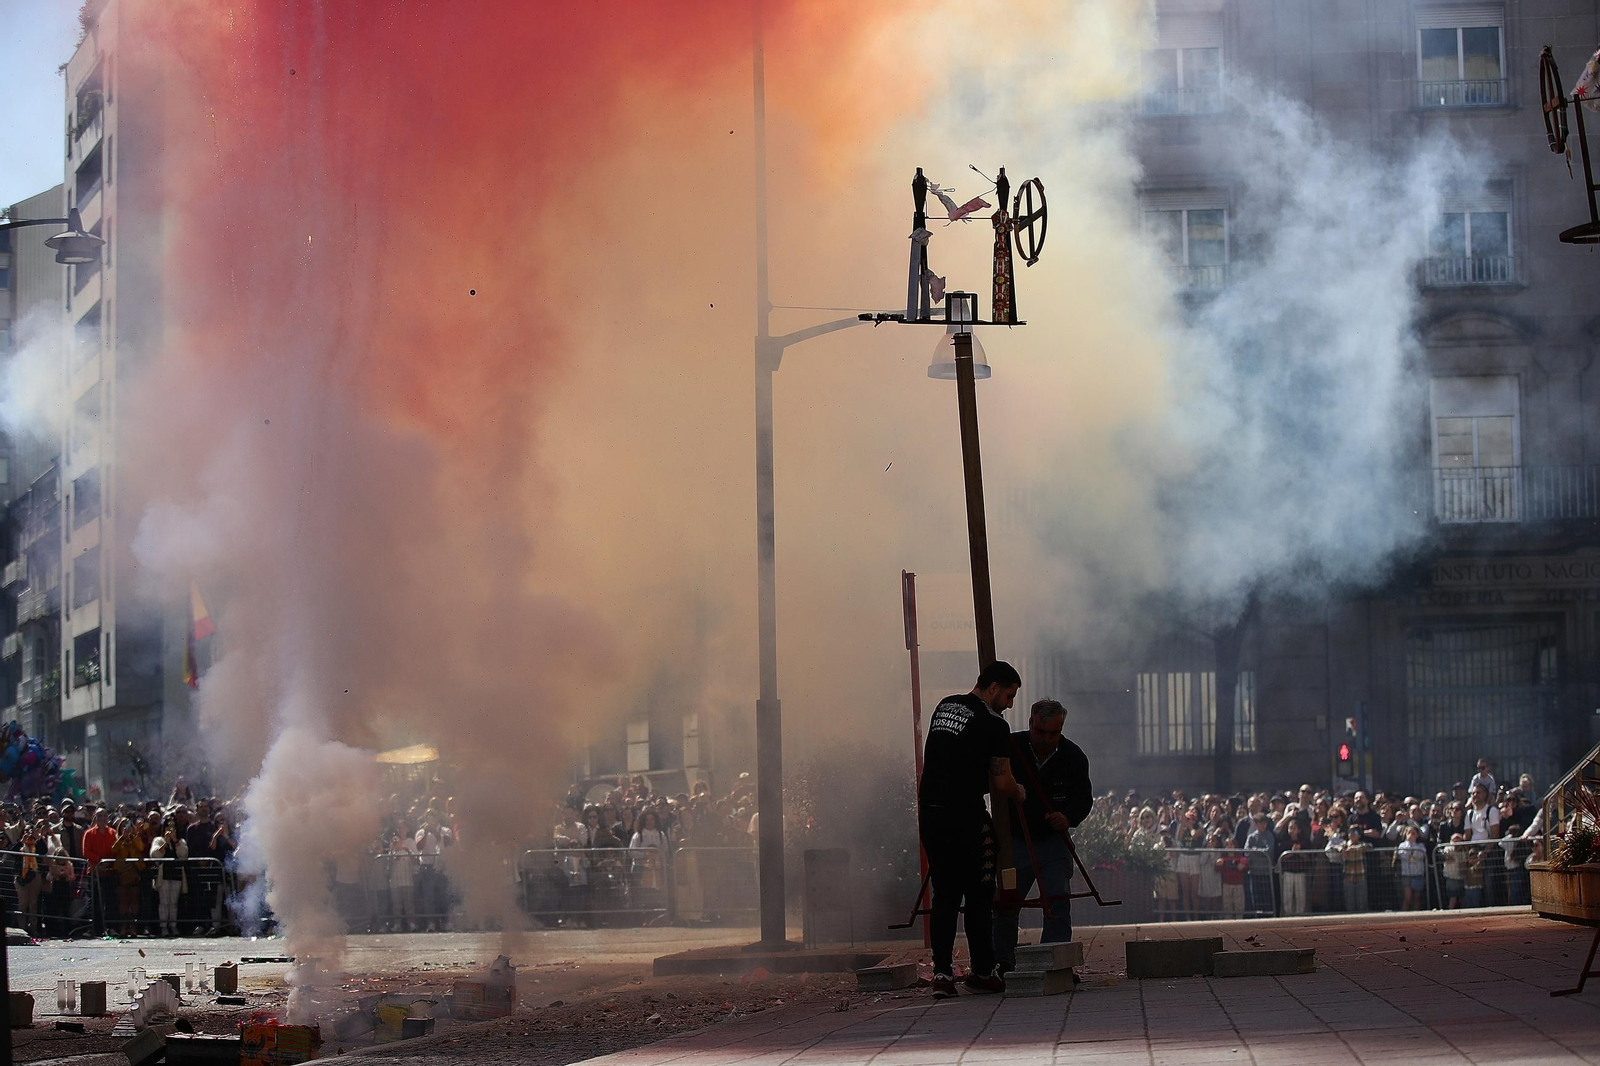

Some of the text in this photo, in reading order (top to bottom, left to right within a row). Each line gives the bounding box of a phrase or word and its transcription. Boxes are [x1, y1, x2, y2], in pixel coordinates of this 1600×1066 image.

[1433, 564, 1532, 581] INSTITUTO
[1545, 589, 1600, 604] GENE
[930, 620, 975, 630] OUREN
[932, 718, 966, 732] JOSMAN
